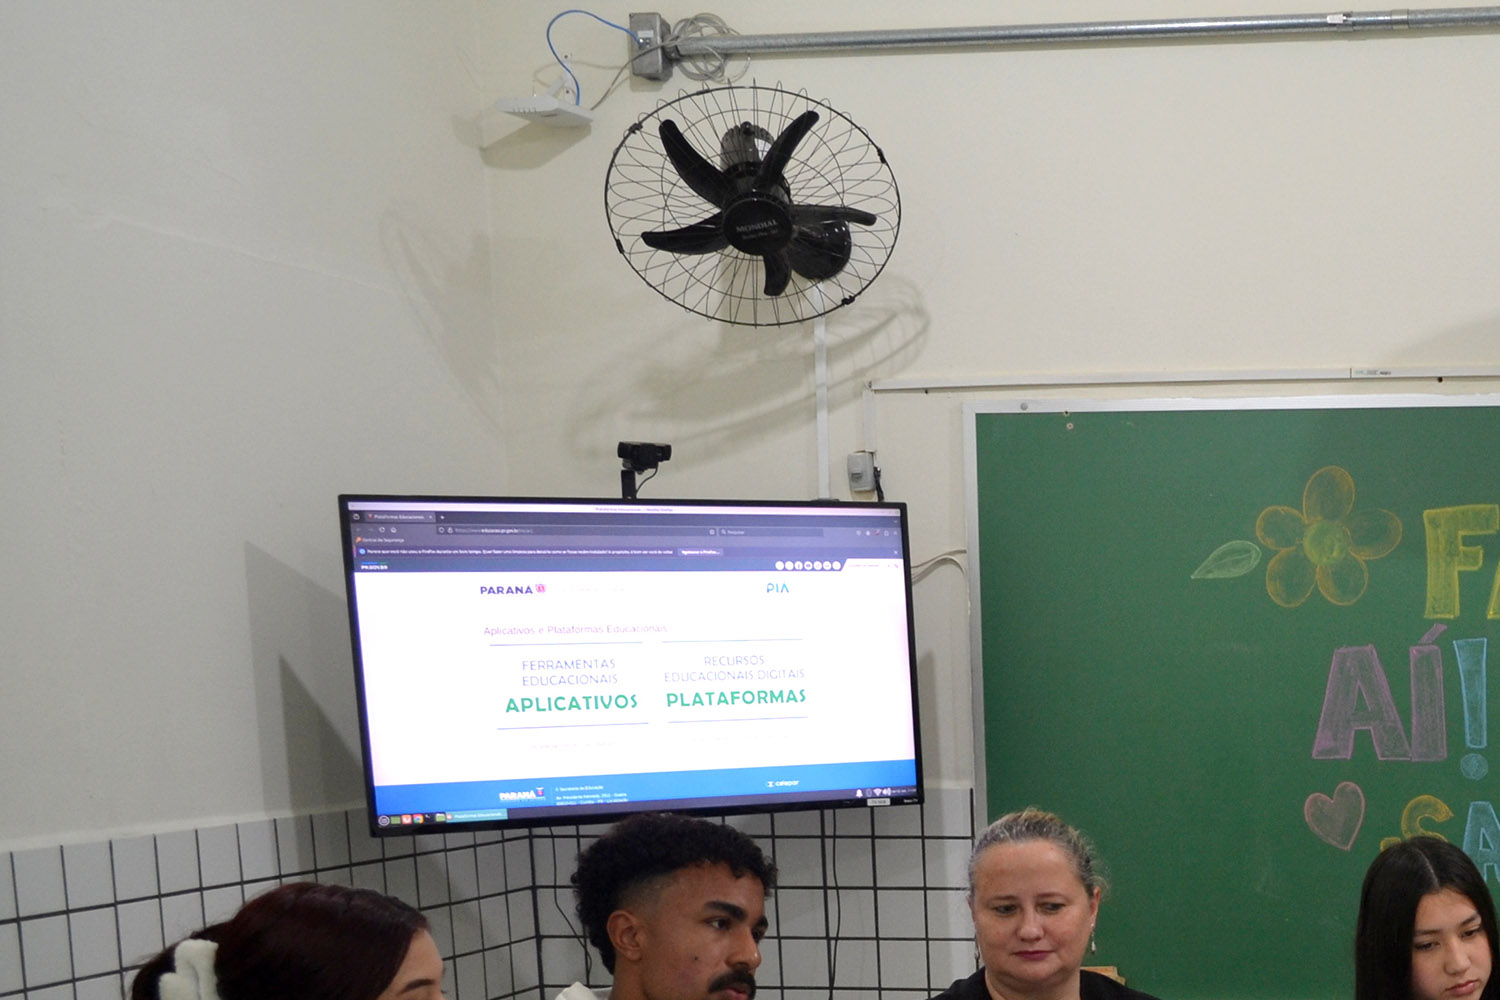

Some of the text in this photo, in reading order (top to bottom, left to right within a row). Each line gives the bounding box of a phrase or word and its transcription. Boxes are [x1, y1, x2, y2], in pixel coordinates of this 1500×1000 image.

[736, 219, 778, 233] MONDIAL
[480, 582, 533, 595] PARANÁ
[483, 626, 535, 637] Aplicativos
[547, 624, 604, 635] Plataformas
[606, 623, 668, 634] Educacionais
[522, 658, 616, 671] FERRAMENTAS
[704, 655, 765, 667] RECURSOS
[522, 674, 618, 687] EDUCACIONAIS
[664, 668, 805, 683] EDUCACIONAIS DIGITAIS
[506, 693, 638, 713] APLICATIVOS
[666, 688, 807, 707] PLATAFORMAS
[1311, 623, 1489, 780] AÍ!
